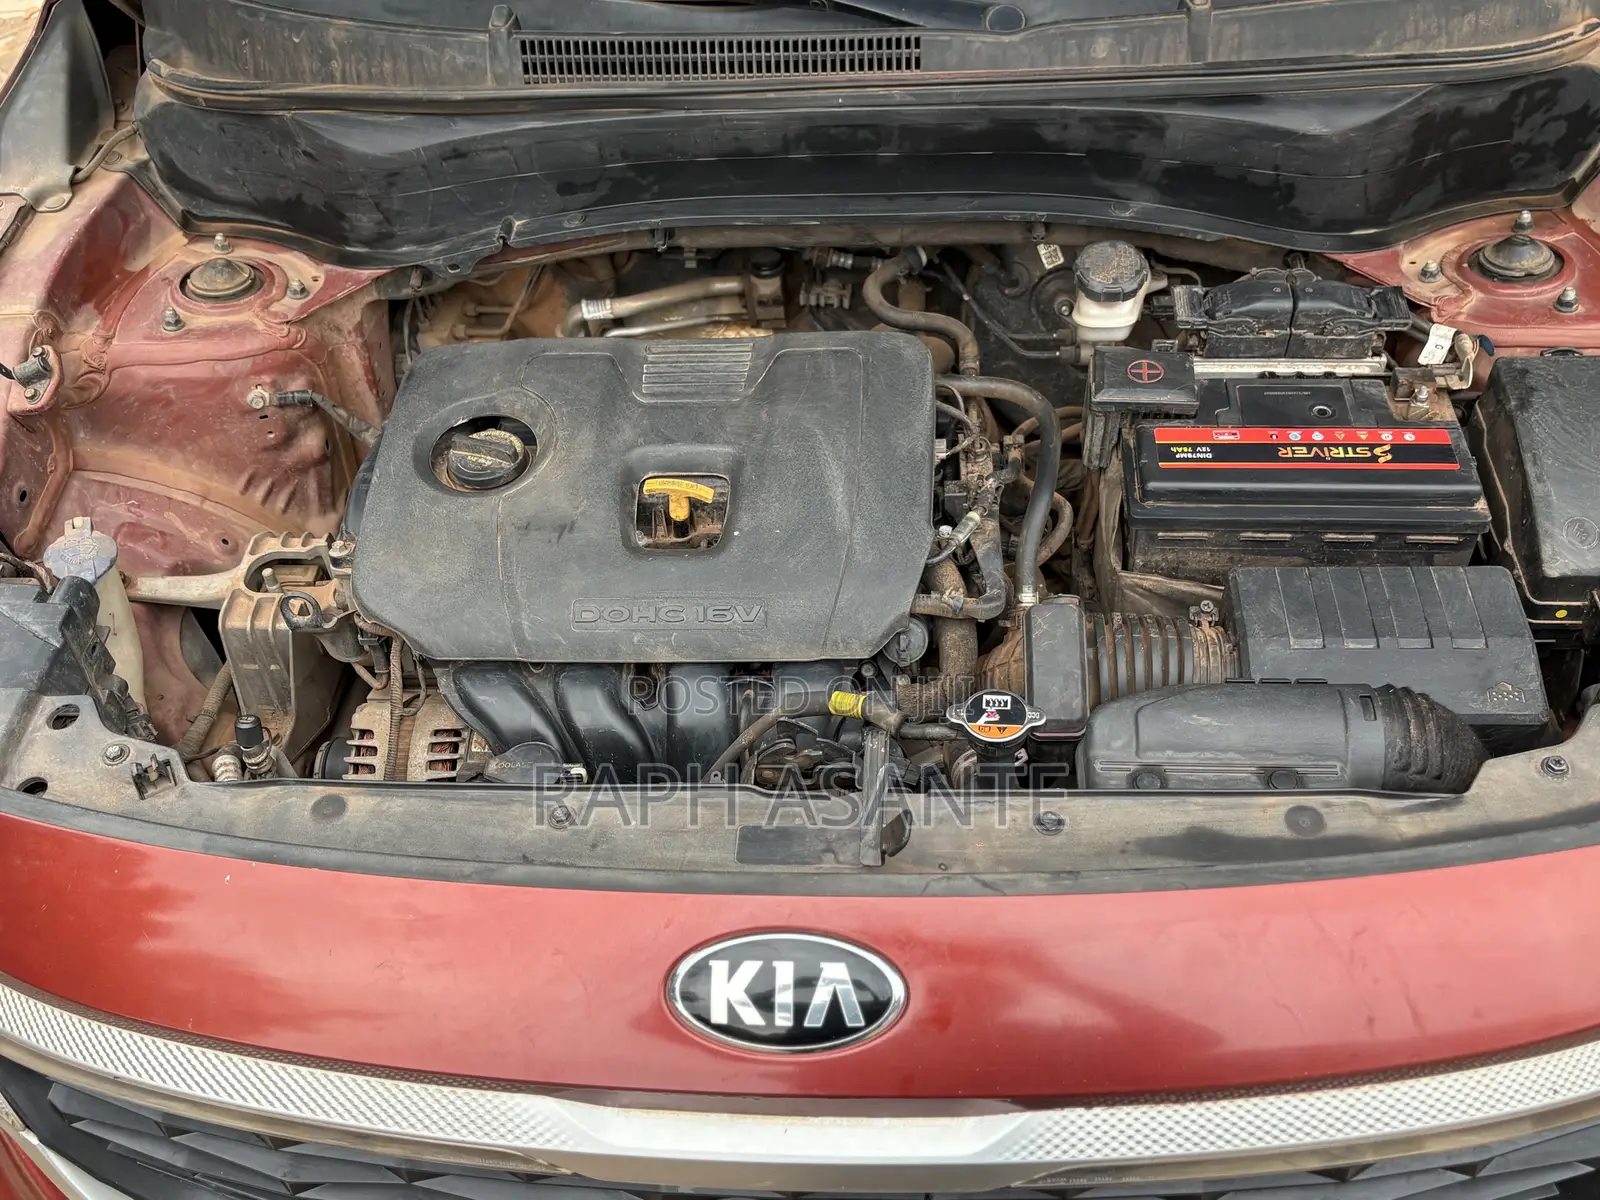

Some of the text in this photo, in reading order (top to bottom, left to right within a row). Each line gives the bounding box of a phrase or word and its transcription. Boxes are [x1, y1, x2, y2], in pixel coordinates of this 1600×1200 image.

[574, 605, 763, 623] DOHC 16V
[708, 960, 866, 1027] KIA
